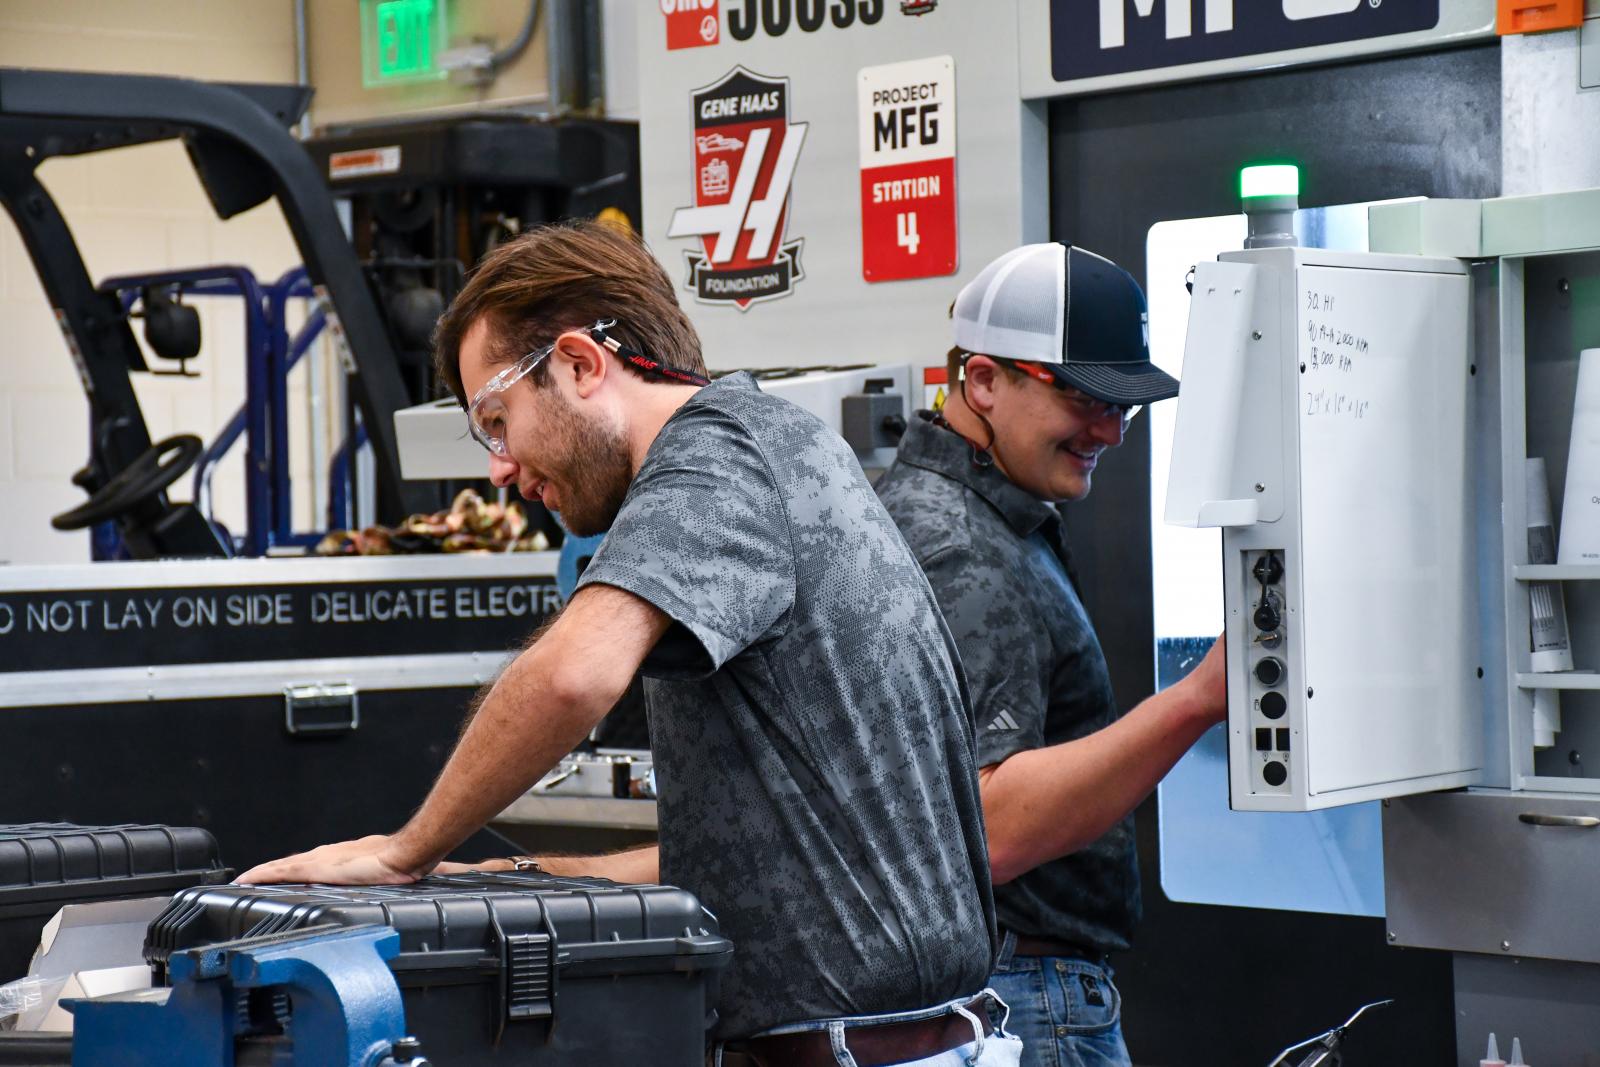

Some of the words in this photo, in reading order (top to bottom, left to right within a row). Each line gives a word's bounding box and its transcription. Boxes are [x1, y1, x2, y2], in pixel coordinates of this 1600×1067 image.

[701, 97, 738, 119] GENE
[740, 91, 780, 113] HAAS
[873, 82, 938, 106] PROJECT
[874, 103, 939, 152] MFG
[872, 175, 941, 204] STATION
[896, 212, 920, 255] 4
[705, 273, 780, 293] FOUNDATION
[26, 600, 92, 632] NOT
[103, 598, 163, 630] LAY
[172, 596, 218, 628] ON
[225, 593, 294, 626] SIDE
[311, 588, 448, 624] DELICATE
